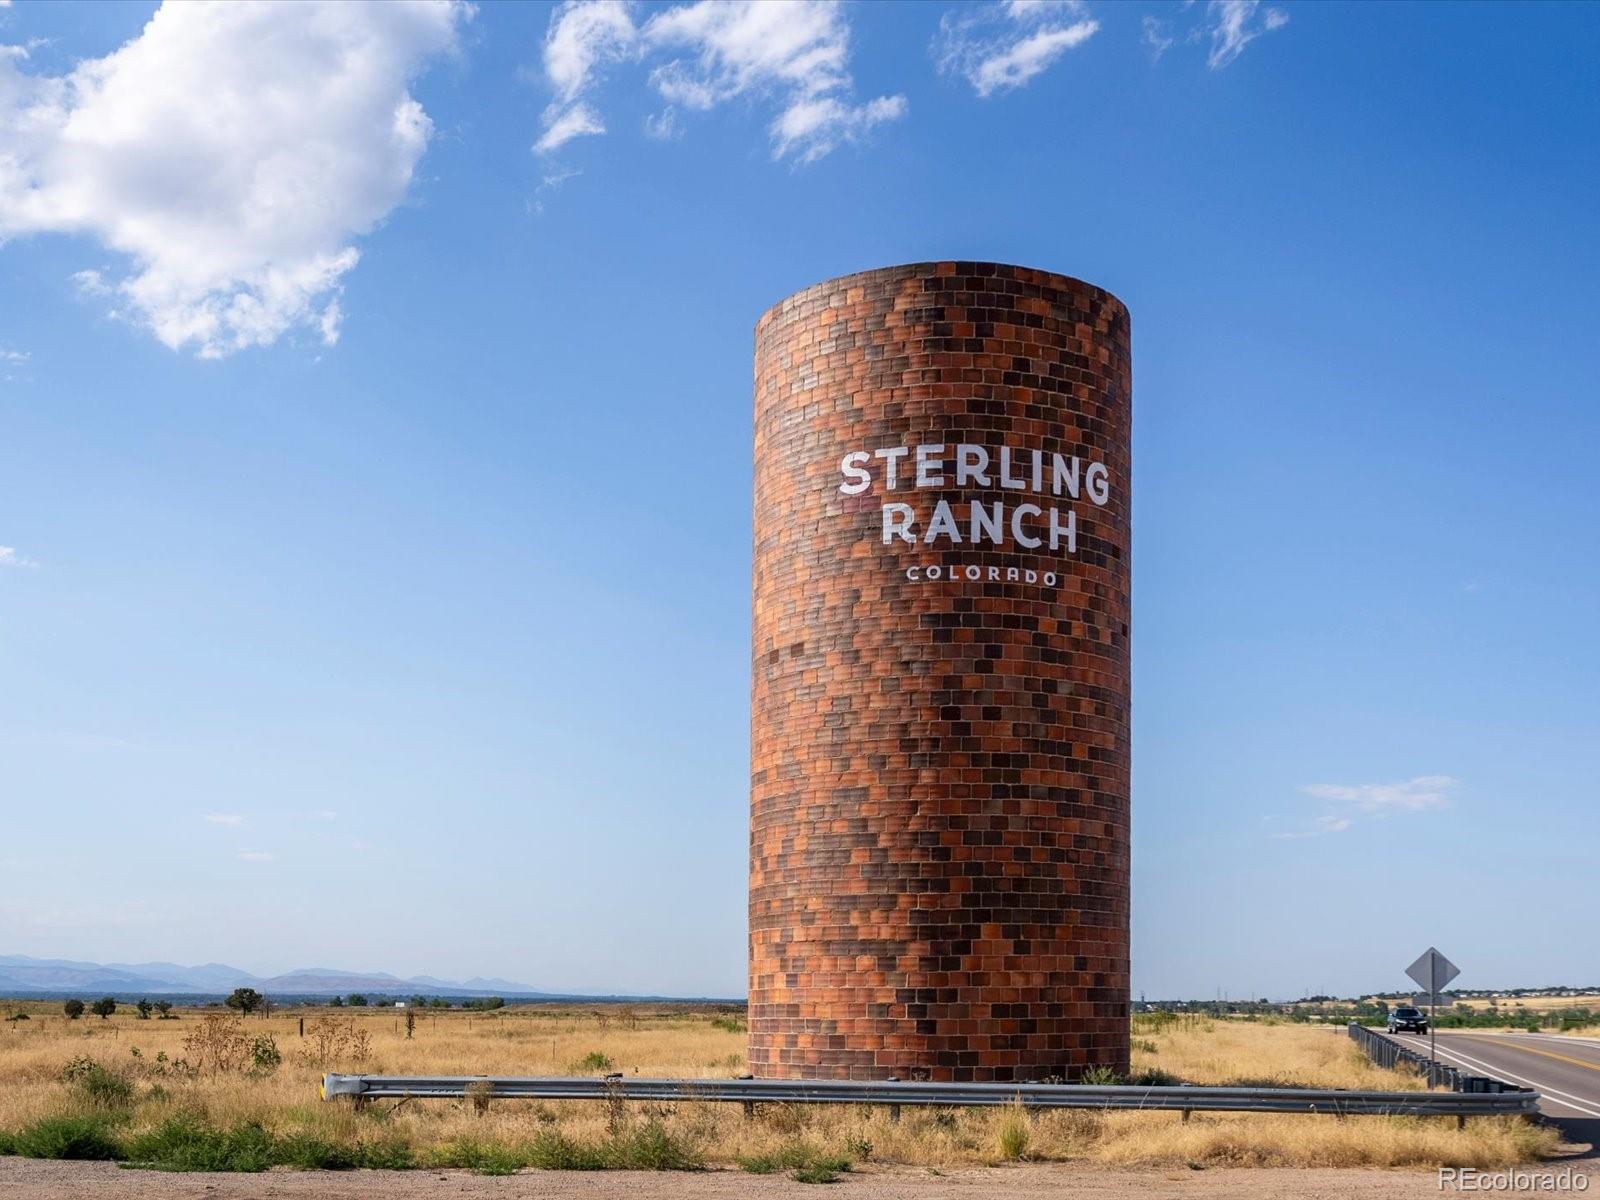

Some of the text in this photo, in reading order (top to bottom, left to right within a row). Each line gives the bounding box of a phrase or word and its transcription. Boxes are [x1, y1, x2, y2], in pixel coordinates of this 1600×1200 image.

[839, 444, 1109, 506] STERLING
[881, 500, 1077, 553] RANCH
[906, 565, 1057, 586] COLORADO
